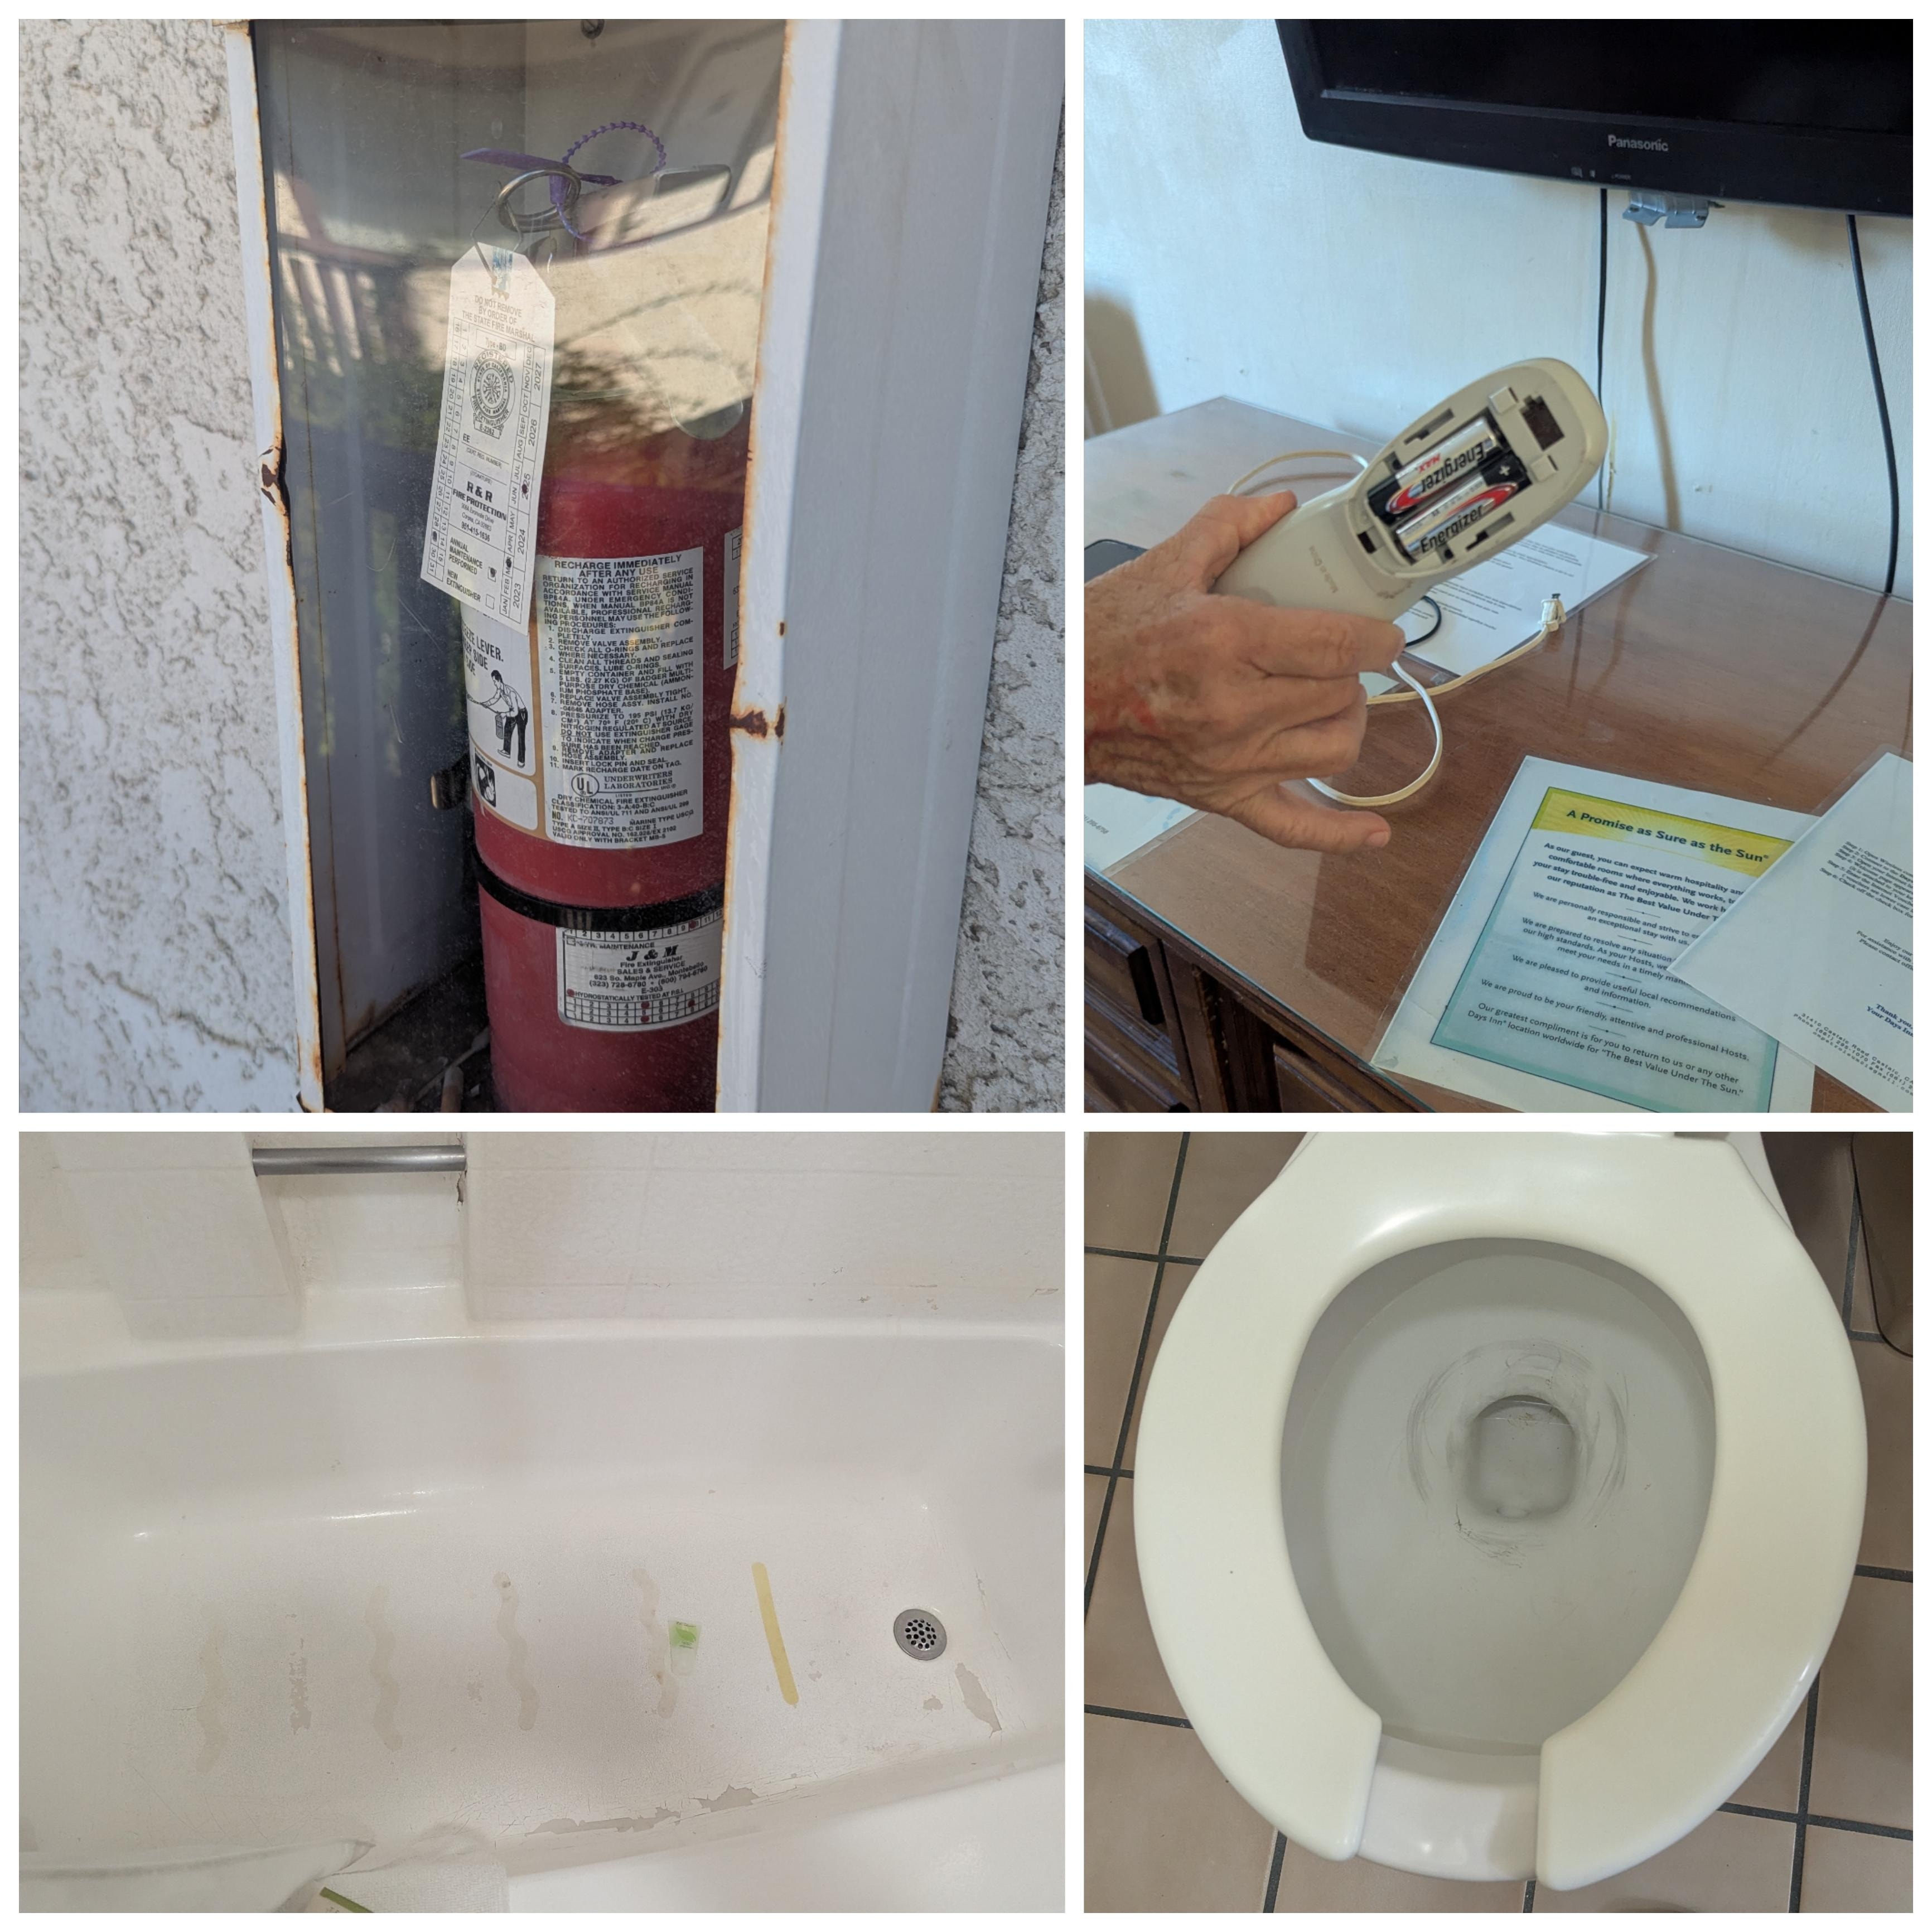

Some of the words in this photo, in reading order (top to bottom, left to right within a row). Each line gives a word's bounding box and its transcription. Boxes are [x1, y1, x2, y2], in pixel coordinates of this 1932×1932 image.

[1608, 134, 1669, 152] Panasonic
[475, 295, 483, 305] DO
[485, 298, 496, 308] NOT
[498, 302, 521, 317] REMOVE
[479, 306, 486, 315] BY
[487, 310, 508, 323] ORDER
[509, 316, 517, 325] OF
[462, 310, 472, 321] THE
[474, 315, 491, 327] STATE
[492, 320, 504, 332] FIRE
[506, 326, 535, 342] MARSHAL
[529, 419, 537, 446] 2026
[1422, 442, 1485, 492] Energizer
[467, 481, 474, 494] R
[475, 486, 482, 498] &
[485, 490, 492, 503] R
[453, 489, 466, 500] FIRE
[467, 496, 506, 521] PROTECTION
[1421, 505, 1484, 553] Energizer
[450, 537, 468, 552] ANNUAL
[449, 554, 477, 575] PERFORMED
[450, 545, 482, 569] MAINTENANCE
[554, 561, 610, 569] RECHARGE
[614, 554, 682, 569] IMMEDIATELY
[447, 569, 458, 581] NEW
[607, 574, 659, 583] AUTHORIZED
[663, 567, 693, 578] SERVICE
[639, 566, 658, 575] USE
[447, 577, 481, 602] EXTINGUISHER
[630, 577, 682, 588] RECHARGING
[476, 635, 504, 661] LEVER.
[661, 636, 693, 648] REPLACE
[603, 770, 673, 782] UNDERWRITERS
[604, 777, 673, 789] LABORATORIES
[635, 789, 688, 803] EXTINGUISHER
[1567, 810, 1576, 818] A
[1581, 813, 1634, 832] Promise
[1637, 827, 1651, 836] as
[1656, 831, 1687, 844] Sure
[1690, 840, 1706, 848] as
[1710, 843, 1732, 854] the
[1572, 851, 1595, 860] guest,
[1631, 864, 1657, 876] expect
[1660, 872, 1682, 881] warm
[1685, 877, 1728, 893] hospitality
[1563, 879, 1605, 893] reputation
[1619, 892, 1634, 901] The
[1637, 897, 1655, 906] Best
[1658, 903, 1680, 912] Value
[1683, 909, 1710, 920] Under
[626, 951, 639, 961] J
[644, 949, 658, 960] &
[663, 945, 678, 958] M
[637, 955, 683, 967] Extinguisher
[653, 961, 685, 972] SERVICE
[1539, 963, 1569, 975] pleased
[1581, 975, 1611, 987] provide
[1613, 983, 1637, 994] useful
[1640, 989, 1659, 1000] local
[1661, 996, 1736, 1022] recommendations
[1481, 979, 1493, 987] We
[1508, 987, 1532, 999] proud
[1557, 1001, 1574, 1010] your
[1576, 1006, 1607, 1021] friendly,
[1610, 1017, 1645, 1030] attentive
[1648, 1027, 1664, 1036] and
[1666, 1032, 1718, 1051] professional
[1722, 1047, 1749, 1061] Hosts.
[1866, 1006, 1884, 1020] Your
[1884, 1017, 1901, 1030] Days
[1876, 1004, 1897, 1020] Thank
[1467, 1011, 1487, 1022] Days
[1508, 1022, 1540, 1036] location
[1543, 1033, 1585, 1050] worldwide
[1587, 1045, 1600, 1054] for
[1624, 1055, 1642, 1066] Best
[1645, 1061, 1668, 1074] Value
[1671, 1070, 1698, 1083] Under
[1701, 1078, 1717, 1089] The
[1479, 1003, 1494, 1012] Our
[1495, 1008, 1528, 1022] greatest
[1530, 1018, 1579, 1037] compliment
[1591, 1035, 1603, 1045] for
[1605, 1040, 1620, 1049] you
[1633, 1048, 1659, 1060] return
[1698, 1066, 1713, 1077] any
[1715, 1071, 1739, 1084] other
[1824, 1026, 1849, 1045] Castaic
[1851, 1044, 1869, 1056] Road
